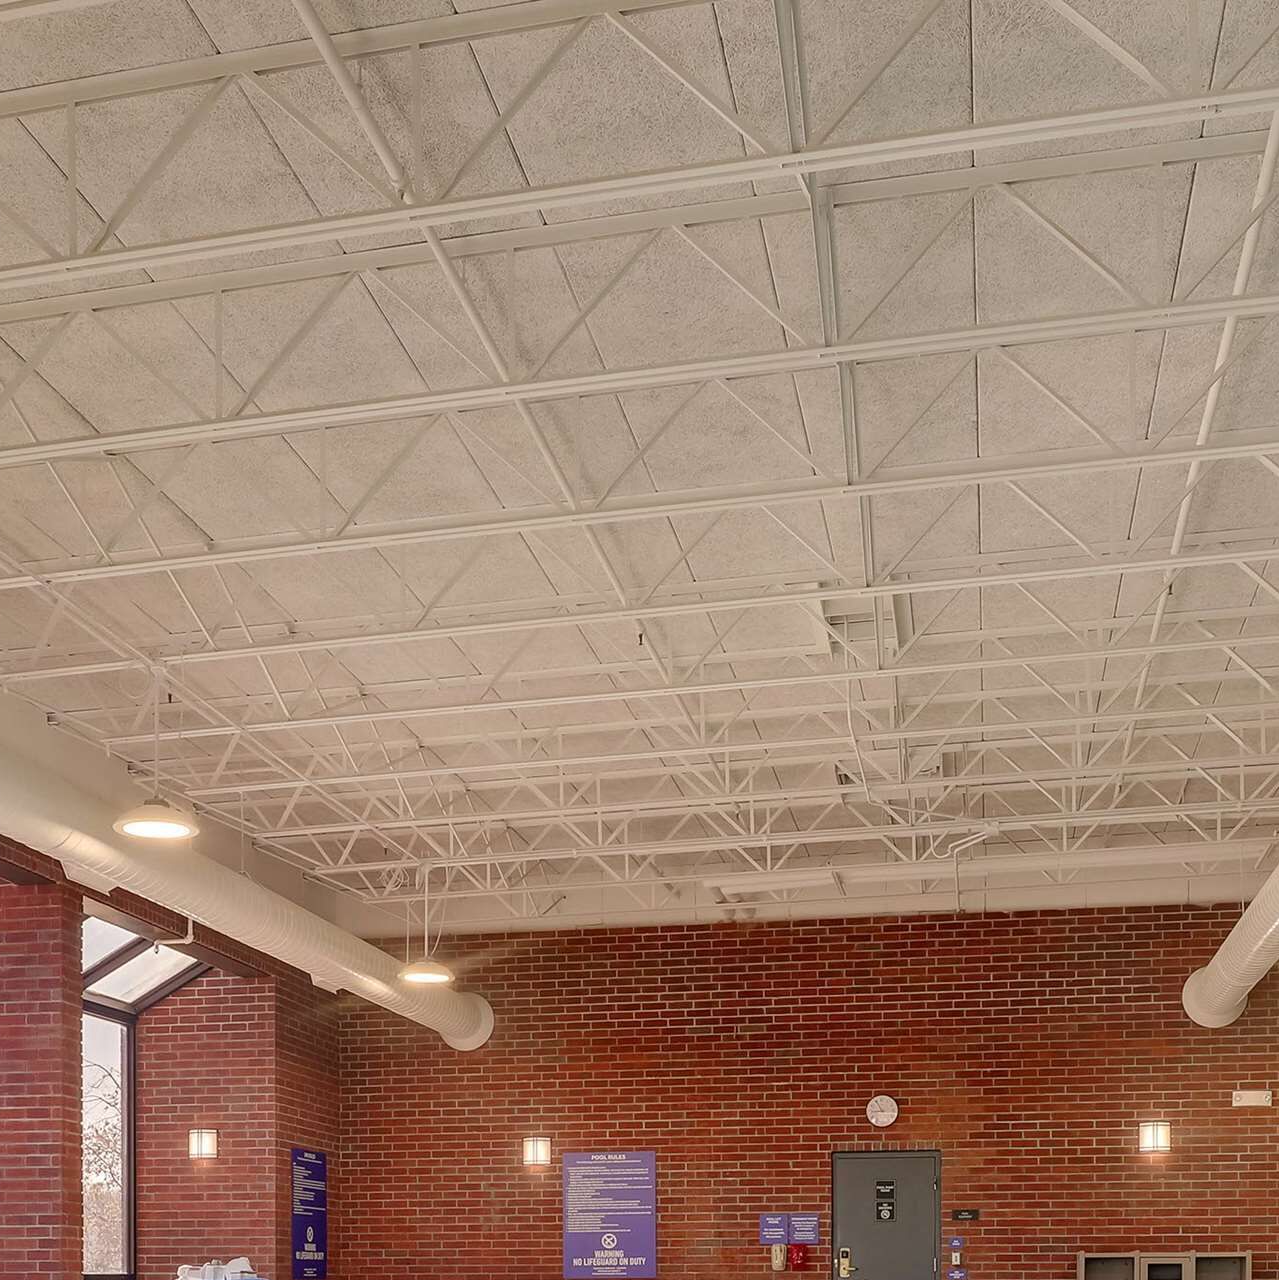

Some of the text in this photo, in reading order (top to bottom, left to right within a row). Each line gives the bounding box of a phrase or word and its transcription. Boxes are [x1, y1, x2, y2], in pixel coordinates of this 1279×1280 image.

[594, 1250, 624, 1258] WARNING
[573, 1257, 646, 1266] NO LIFEGUARD ON DUTY
